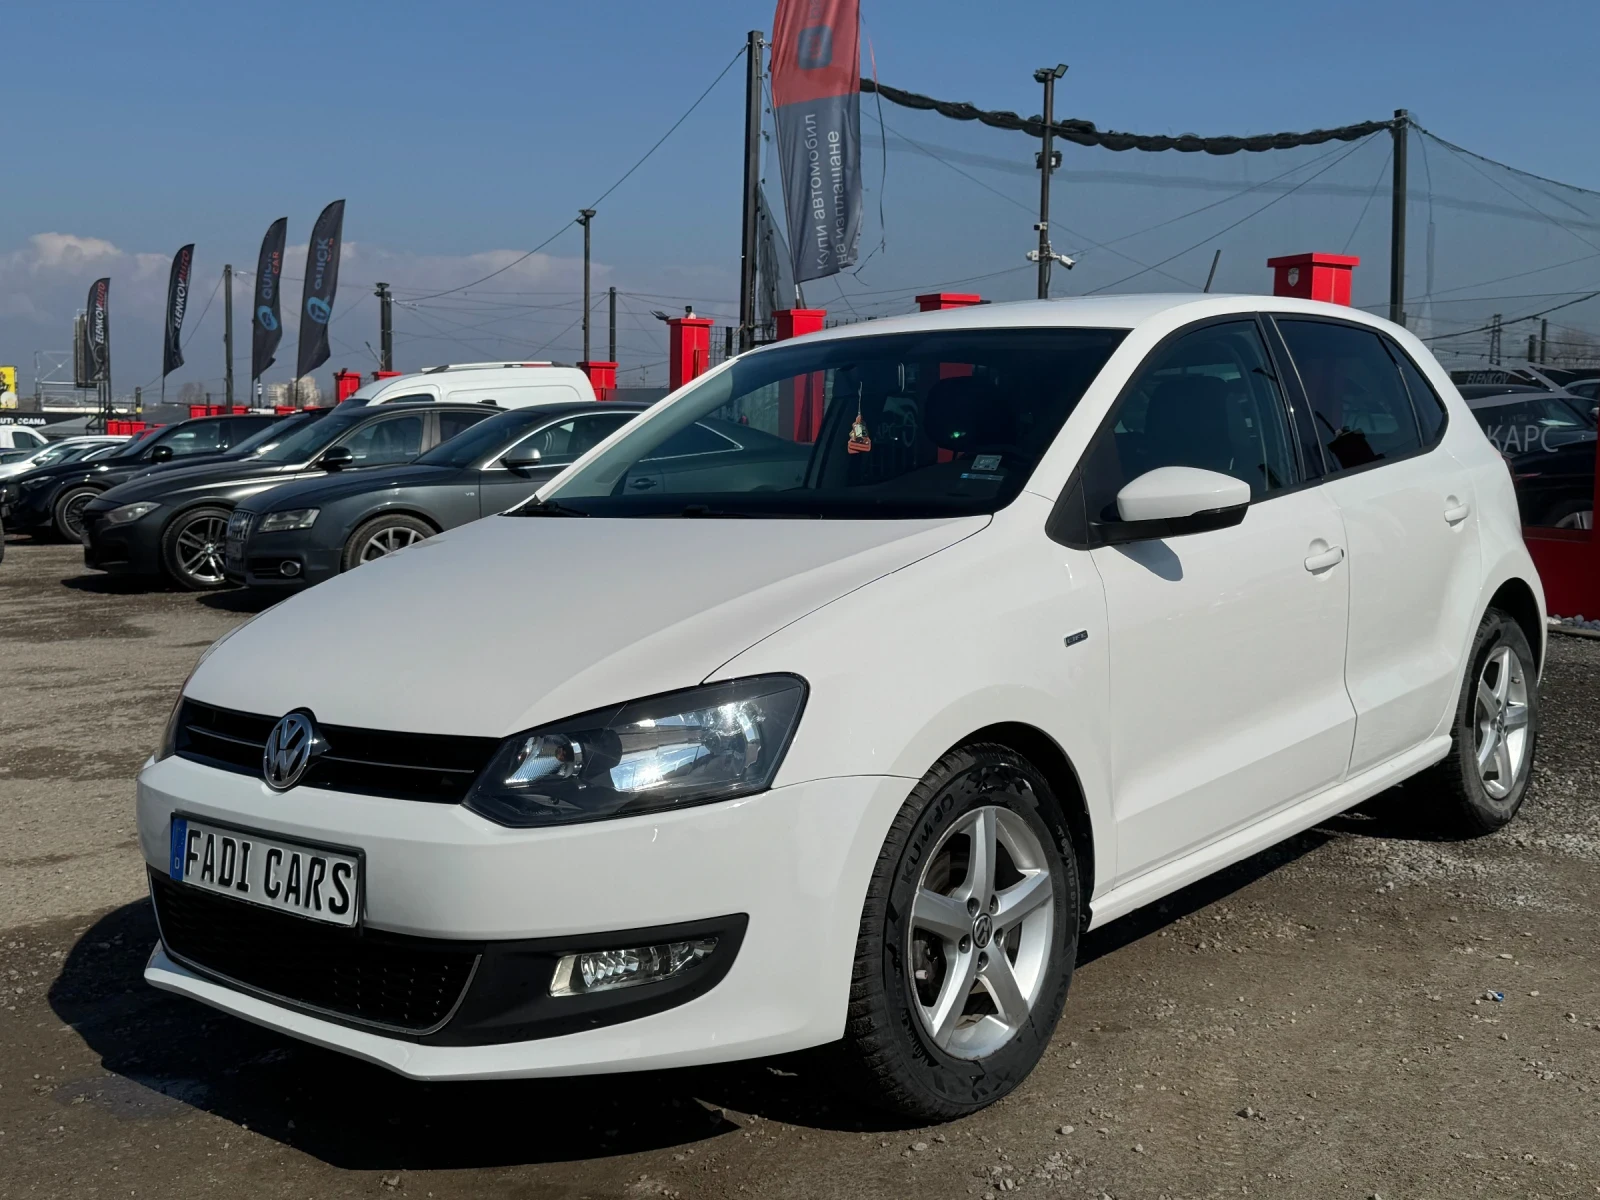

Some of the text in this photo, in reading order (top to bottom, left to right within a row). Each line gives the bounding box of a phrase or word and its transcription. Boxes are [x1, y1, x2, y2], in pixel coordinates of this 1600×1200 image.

[804, 113, 829, 270] Купи автомобил
[828, 130, 846, 240] изплащане
[272, 251, 280, 275] CAR
[1465, 372, 1511, 385] ELENKOV
[174, 829, 352, 915] D FADI CARS
